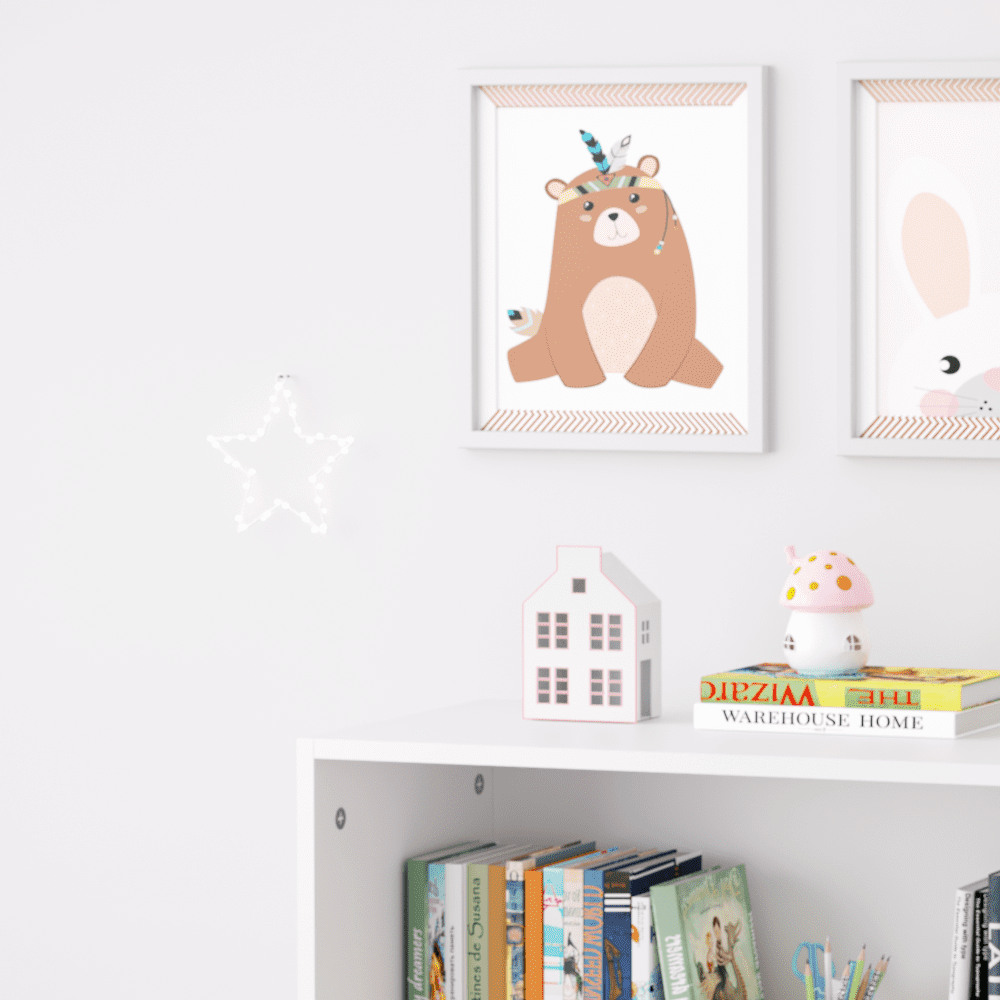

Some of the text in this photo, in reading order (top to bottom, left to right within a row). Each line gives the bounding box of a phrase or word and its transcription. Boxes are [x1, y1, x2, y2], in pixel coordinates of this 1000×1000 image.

[849, 687, 920, 706] THE
[722, 708, 924, 730] WAREHOUSE HOME
[468, 877, 484, 939] Susana
[961, 893, 971, 927] Designing
[407, 927, 424, 992] dreamers
[468, 943, 481, 962] de
[960, 945, 968, 960] type
